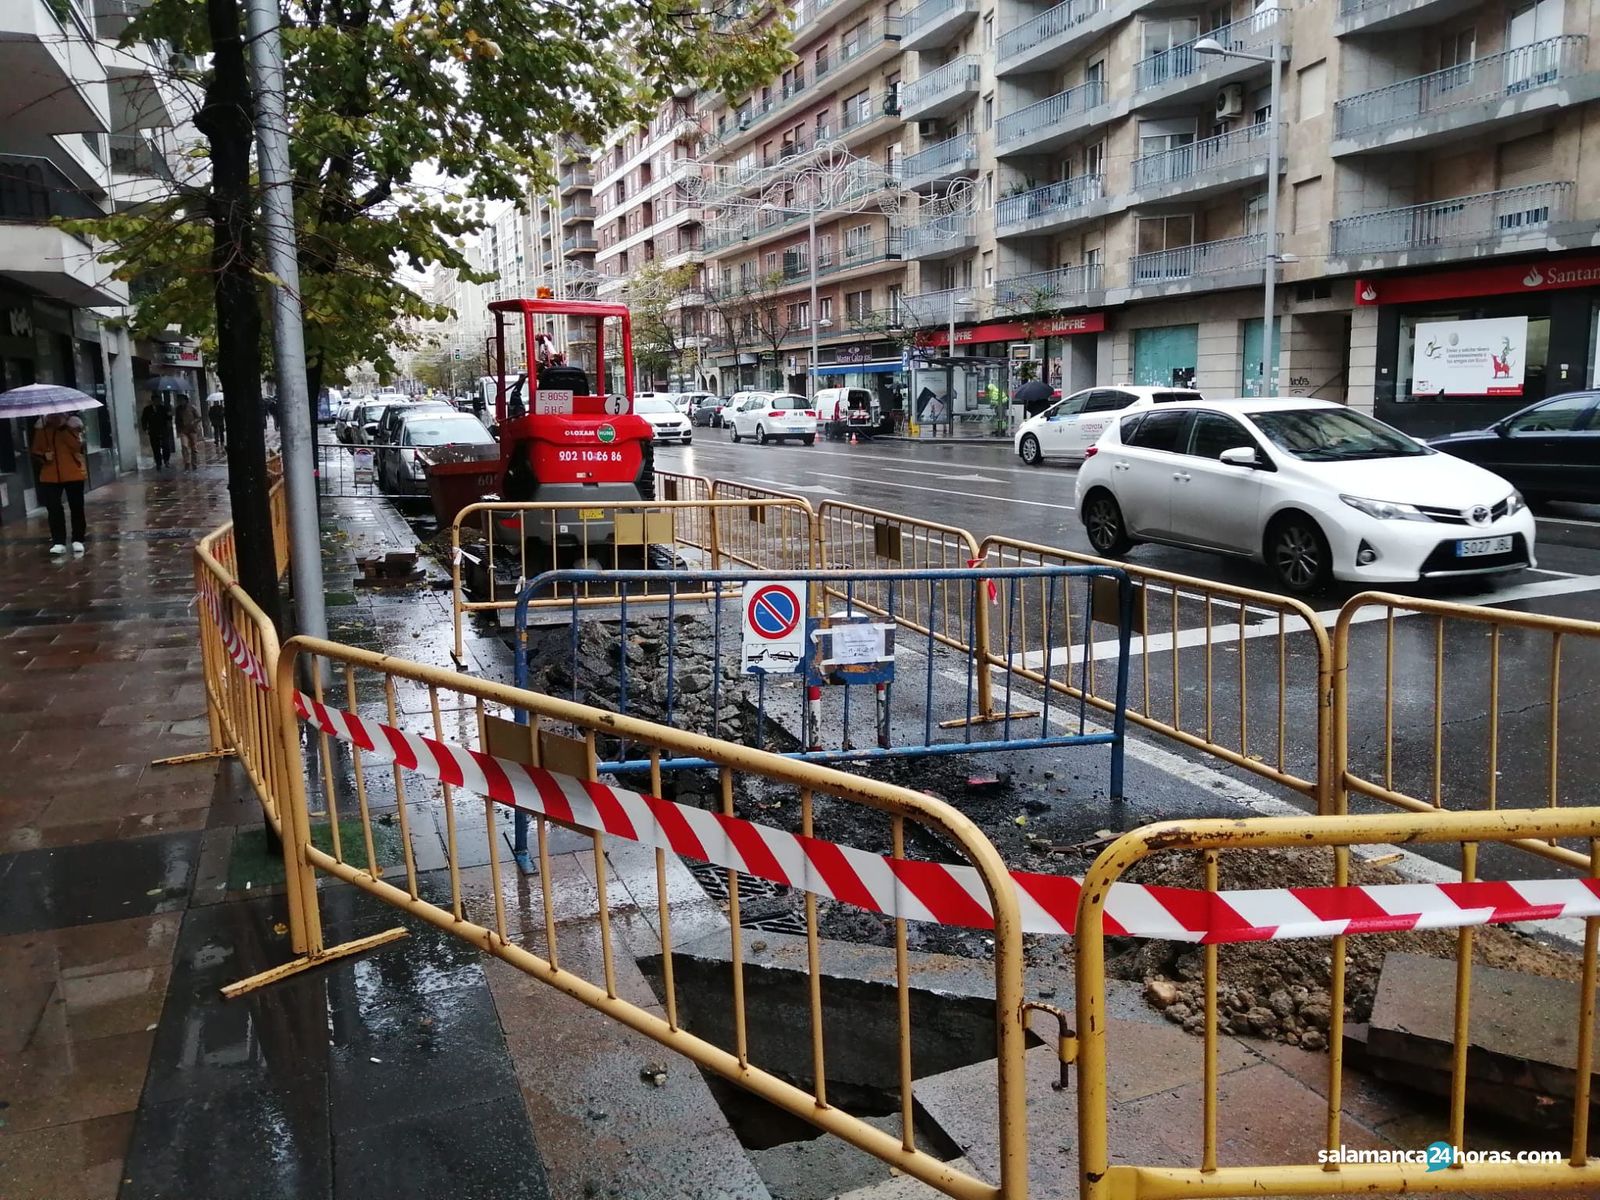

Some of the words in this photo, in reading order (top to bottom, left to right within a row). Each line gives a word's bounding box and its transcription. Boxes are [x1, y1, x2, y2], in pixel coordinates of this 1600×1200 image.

[1051, 319, 1086, 331] MAPFRE
[540, 392, 546, 401] E
[613, 396, 622, 414] 5
[559, 451, 578, 461] 902
[582, 451, 593, 461] 10
[611, 451, 622, 461] 86
